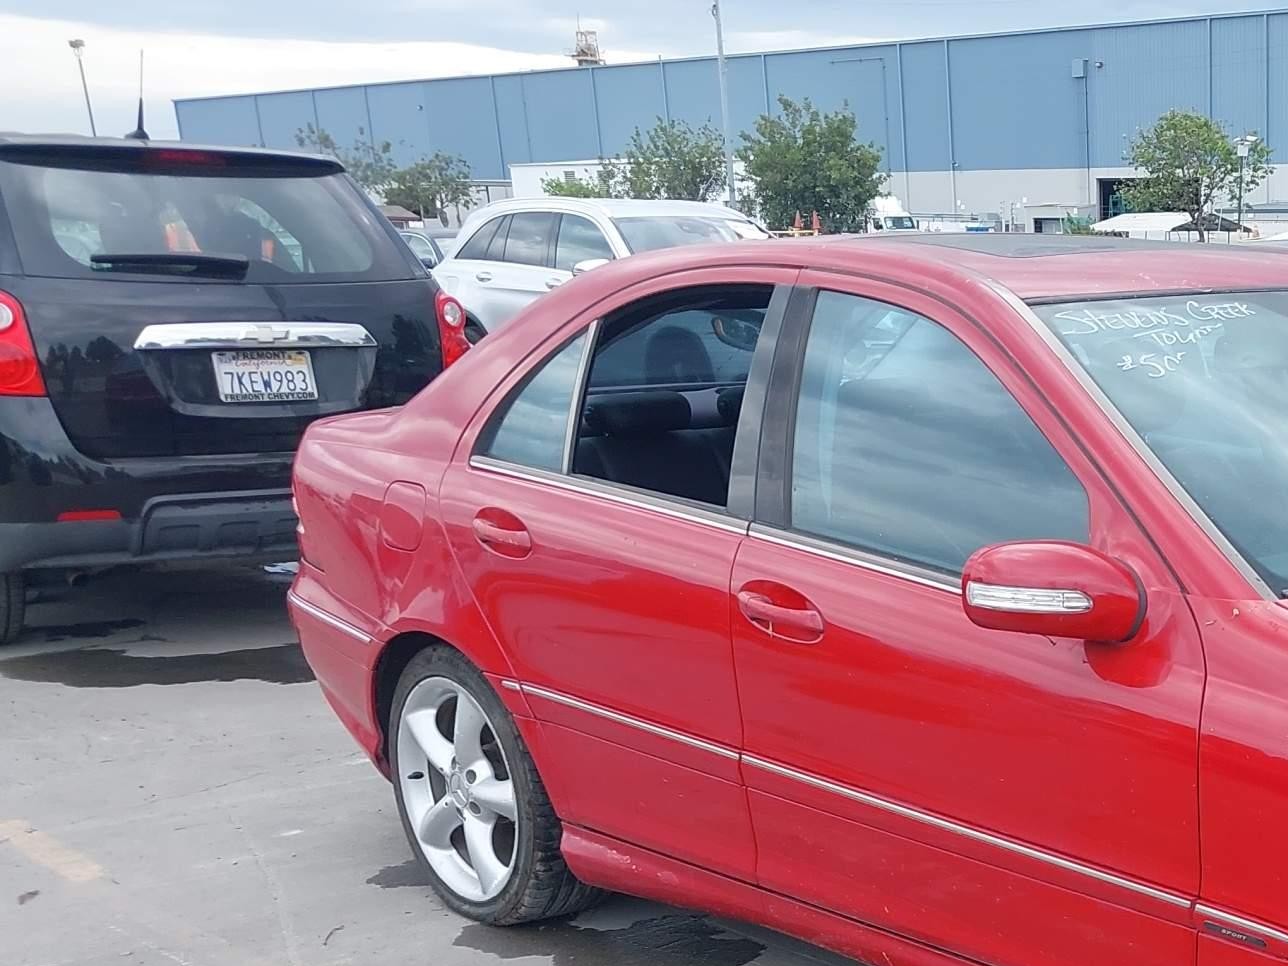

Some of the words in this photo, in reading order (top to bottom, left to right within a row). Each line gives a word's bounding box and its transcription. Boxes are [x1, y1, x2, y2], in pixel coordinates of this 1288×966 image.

[235, 351, 287, 360] FREMONT
[224, 370, 309, 392] 7KEW983
[225, 393, 265, 401] FREMONT
